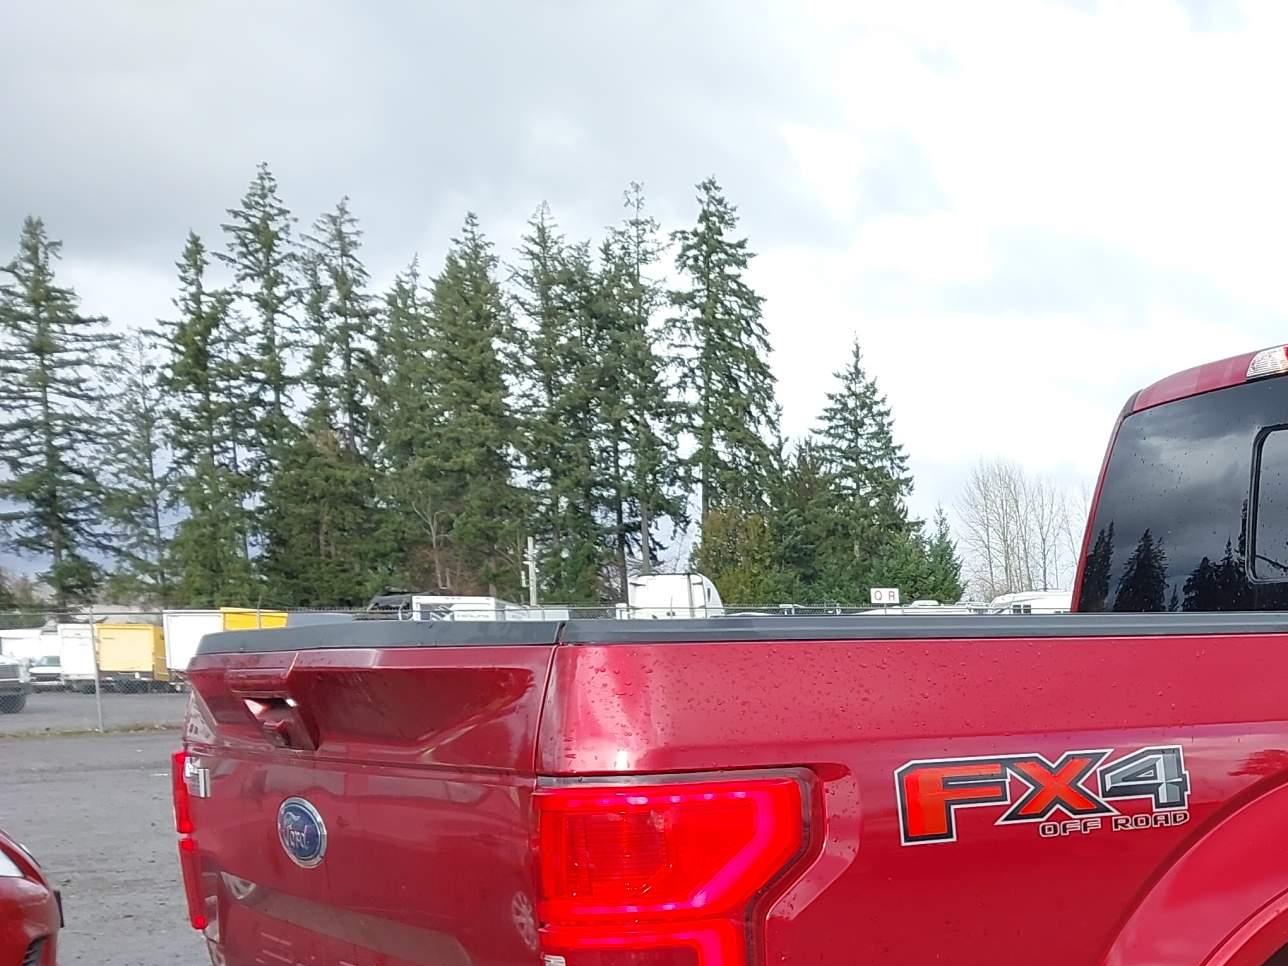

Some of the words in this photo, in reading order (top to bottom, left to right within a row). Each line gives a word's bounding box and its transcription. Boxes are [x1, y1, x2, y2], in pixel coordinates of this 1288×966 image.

[894, 745, 1191, 846] FX4
[283, 811, 312, 850] Ford
[1039, 818, 1102, 837] OFF
[1112, 811, 1190, 831] ROAD
